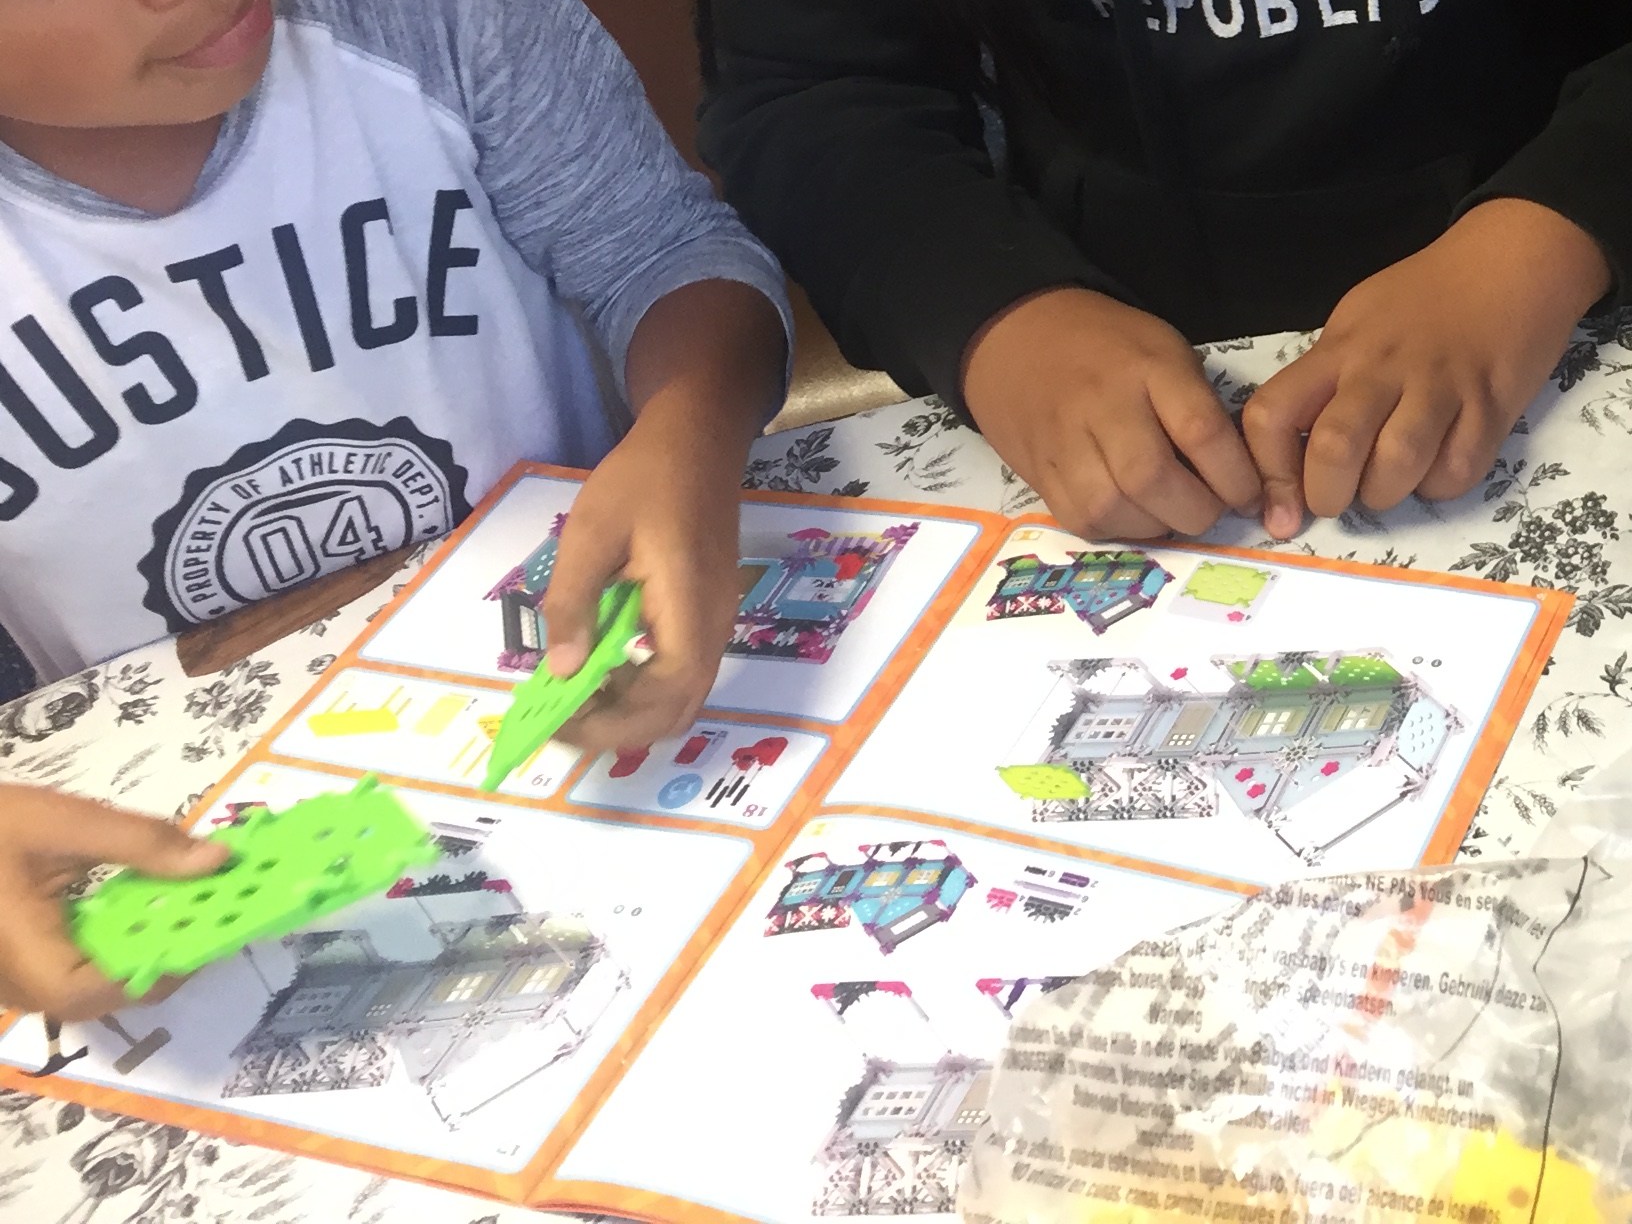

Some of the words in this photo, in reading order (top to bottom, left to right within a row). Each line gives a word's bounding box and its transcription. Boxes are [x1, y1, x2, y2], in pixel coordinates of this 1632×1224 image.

[181, 500, 232, 604] PROPERTY
[230, 478, 264, 500] OF
[278, 451, 394, 488] ATHLETIC
[391, 458, 440, 520] DEPT.
[242, 495, 387, 593] 04
[741, 803, 769, 818] 18
[1365, 874, 1386, 893] NE
[1390, 876, 1417, 899] PAS
[1455, 892, 1473, 911] en
[1351, 961, 1368, 979] en
